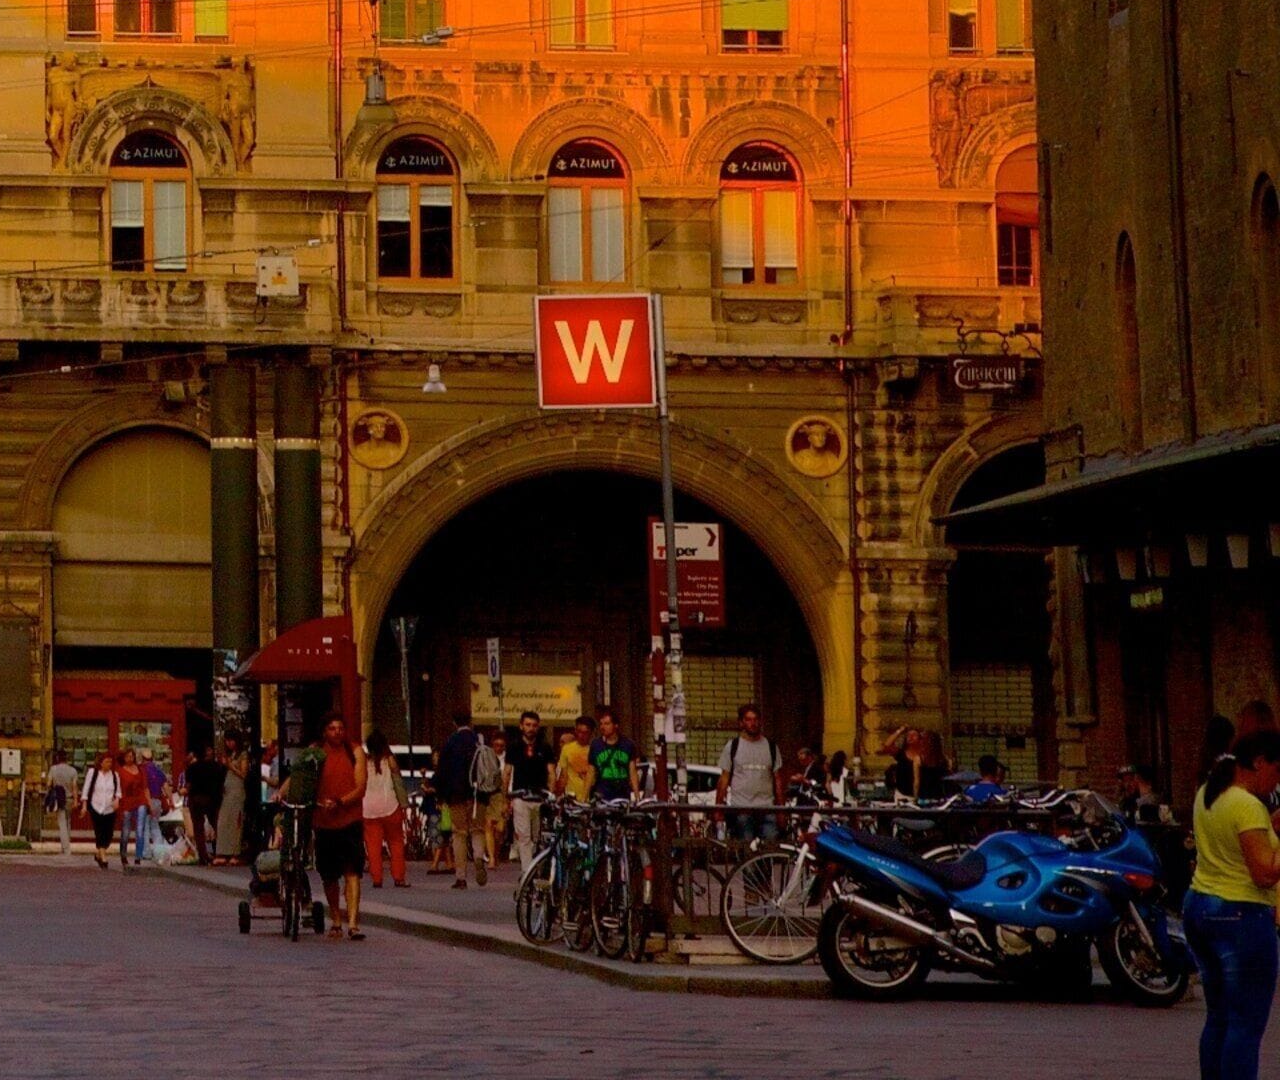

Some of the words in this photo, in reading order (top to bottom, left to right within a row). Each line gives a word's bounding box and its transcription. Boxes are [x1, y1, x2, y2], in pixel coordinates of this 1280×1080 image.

[134, 147, 179, 159] AZIMUT
[400, 155, 445, 166] AZIMUT
[570, 158, 616, 169] AZIMUT
[742, 161, 788, 172] AZIMUT
[554, 319, 634, 384] W
